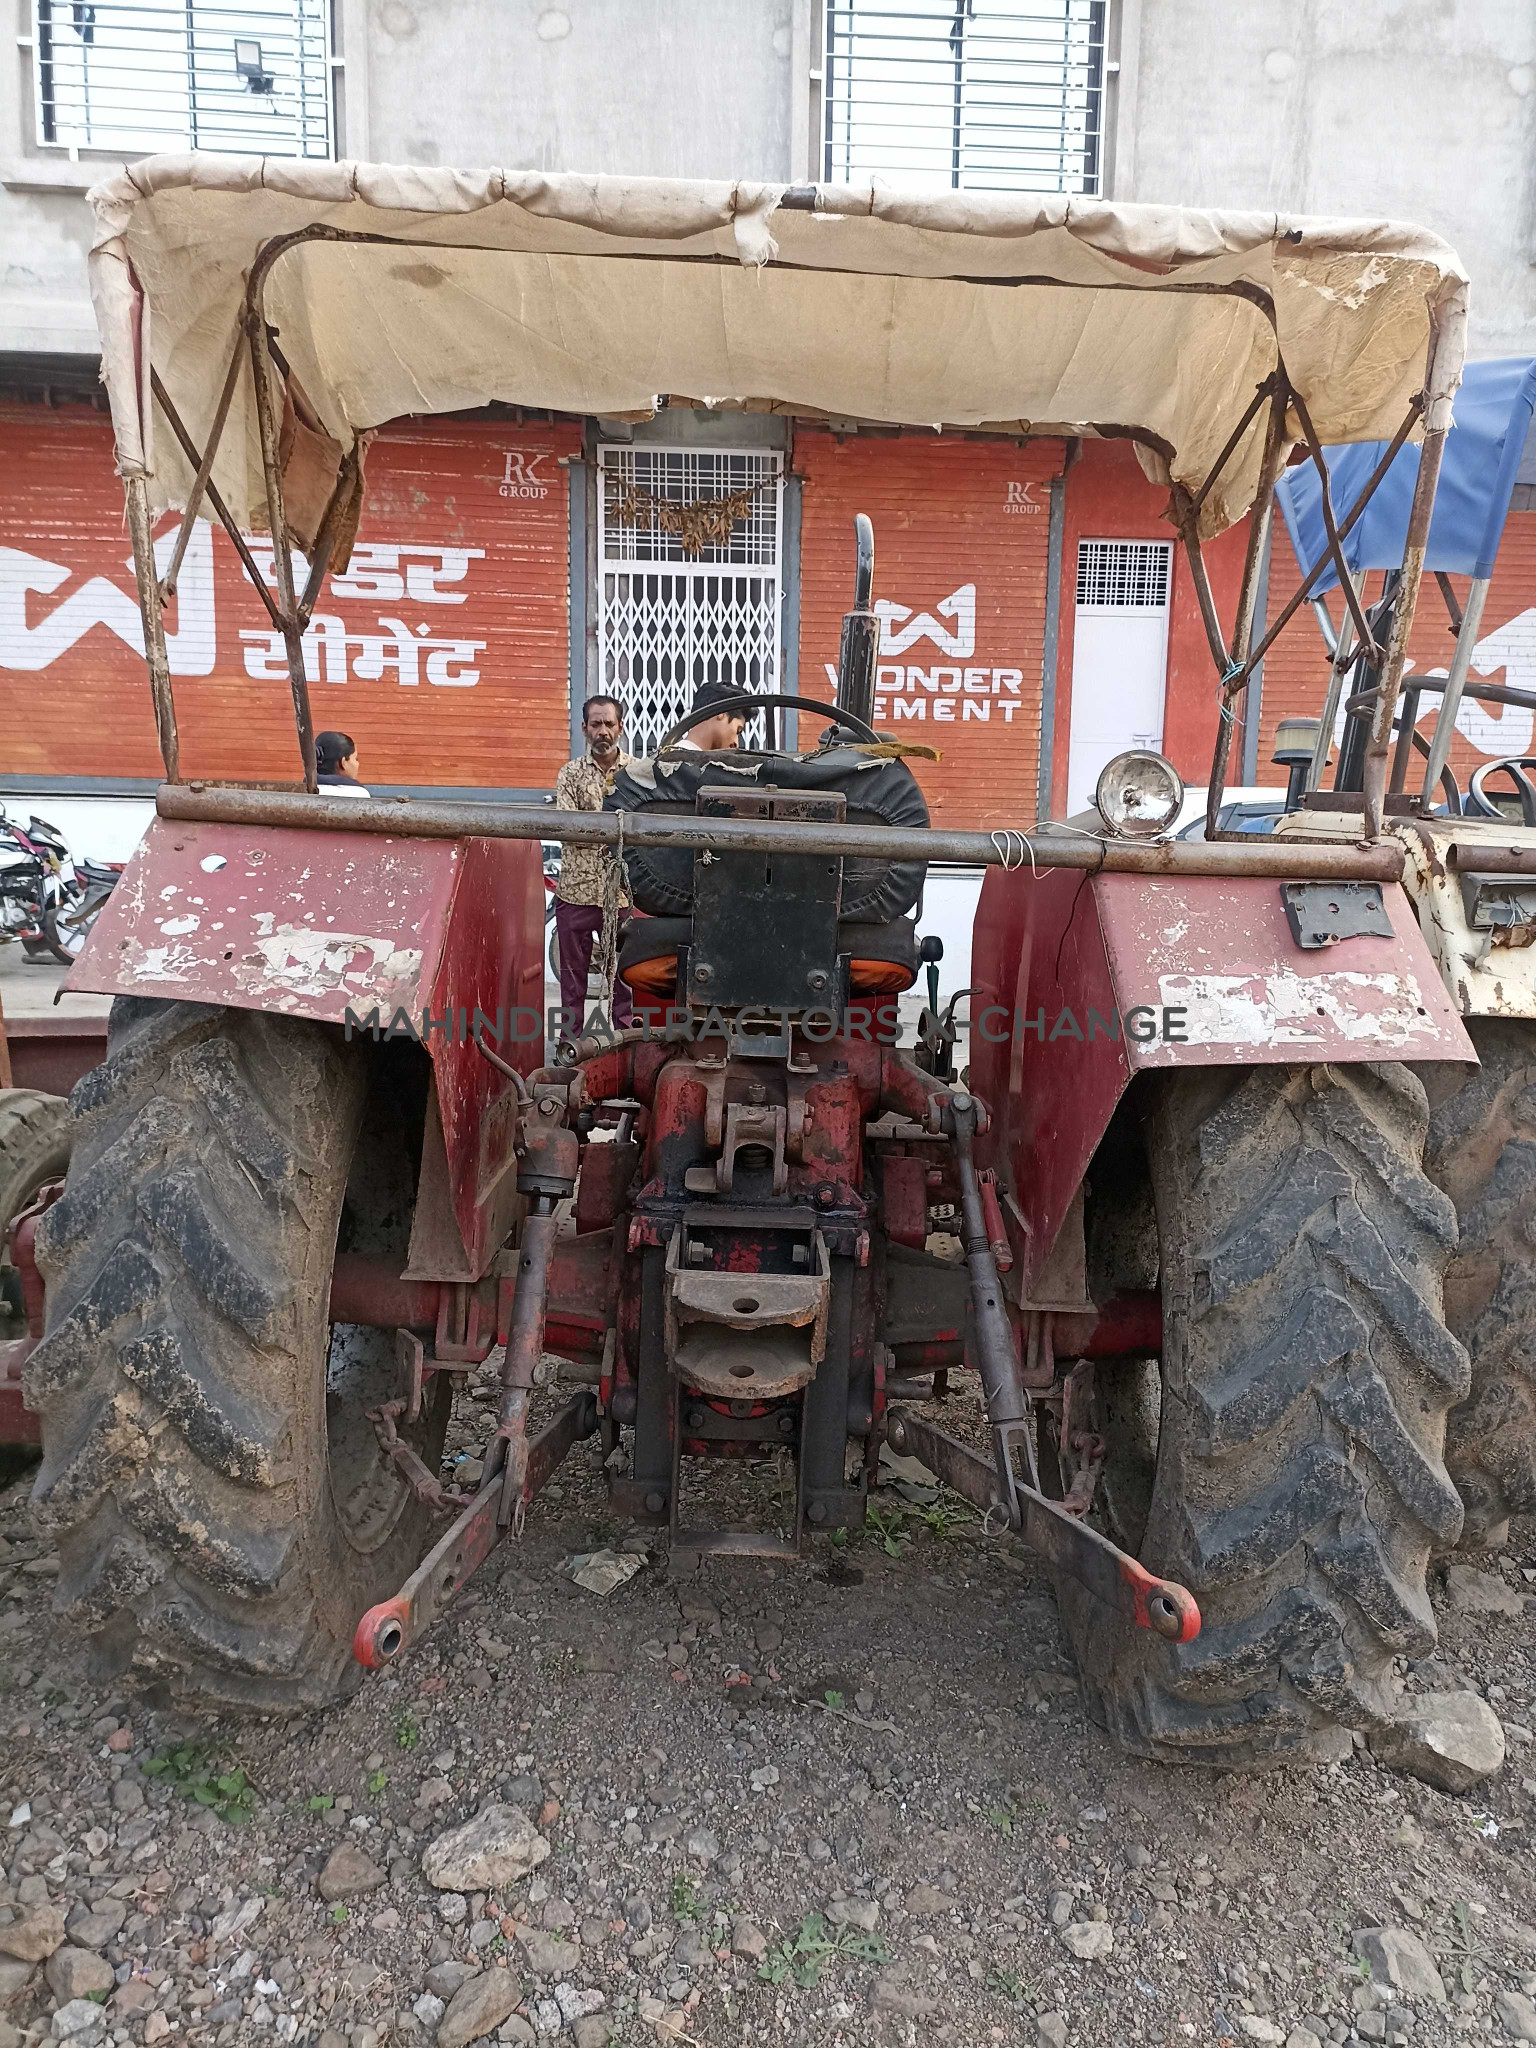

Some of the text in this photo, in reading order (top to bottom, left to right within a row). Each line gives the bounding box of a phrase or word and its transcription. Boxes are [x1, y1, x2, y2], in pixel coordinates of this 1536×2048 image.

[501, 452, 549, 486] RK
[498, 485, 548, 499] GROUP
[1005, 481, 1037, 504] RK
[1002, 504, 1041, 514] GROUP
[238, 613, 487, 687] सीमेंट
[832, 696, 1022, 723] EMENT
